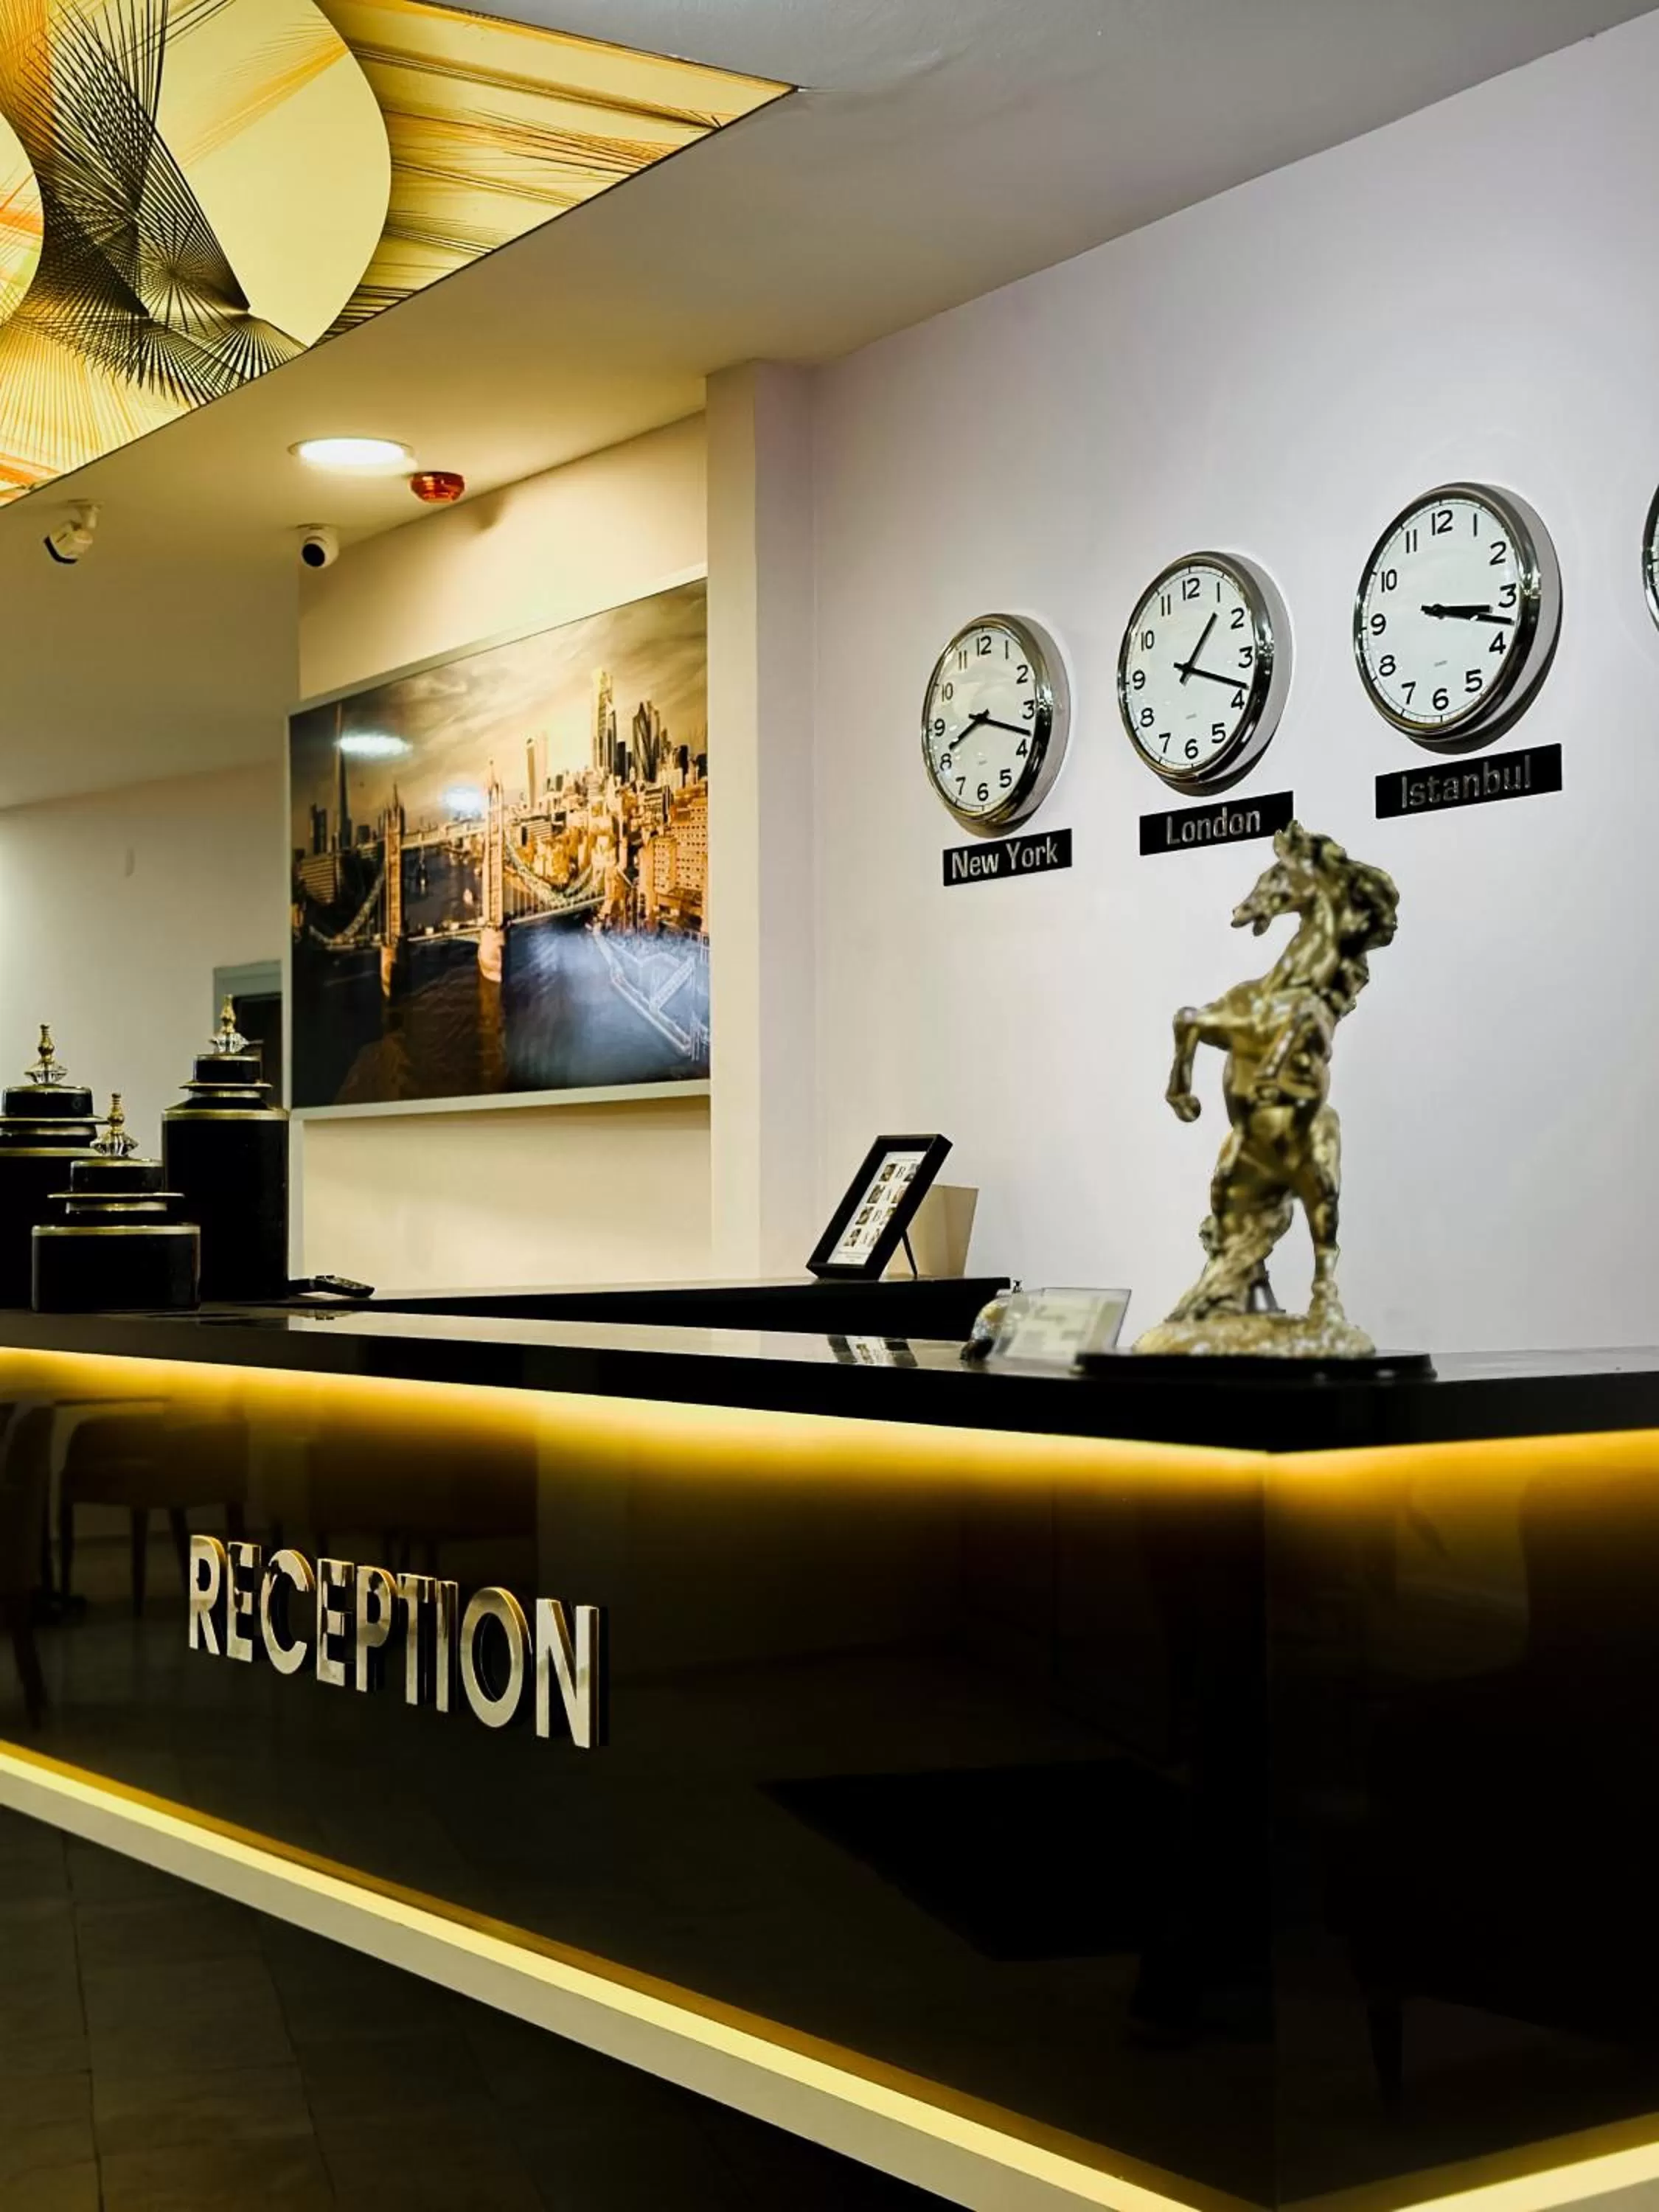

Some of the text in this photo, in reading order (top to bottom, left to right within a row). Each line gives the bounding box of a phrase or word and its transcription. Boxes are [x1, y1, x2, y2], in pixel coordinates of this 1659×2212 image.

[1431, 509, 1453, 536] 12
[1405, 529, 1418, 554] 11
[1489, 540, 1507, 566] 2
[1182, 577, 1200, 601] 12
[1381, 568, 1397, 593] 10
[1161, 594, 1172, 617] 11
[1498, 582, 1517, 608] 3
[1230, 607, 1245, 630] 2
[1370, 613, 1387, 636] 9
[975, 635, 992, 656] 12
[1141, 629, 1155, 652] 10
[1489, 630, 1506, 655] 4
[958, 649, 968, 670] 11
[1238, 645, 1253, 669] 3
[1378, 654, 1397, 678] 8
[1016, 664, 1029, 685] 2
[1132, 669, 1146, 691] 9
[1464, 669, 1483, 693] 5
[941, 682, 954, 703] 10
[1231, 689, 1245, 711] 4
[1401, 681, 1416, 705] 7
[1432, 687, 1450, 712] 6
[1022, 699, 1035, 720] 3
[1139, 707, 1155, 728] 8
[933, 717, 946, 737] 9
[1211, 722, 1228, 745] 5
[1015, 738, 1029, 759] 4
[1158, 732, 1172, 754] 7
[1184, 738, 1199, 760] 6
[939, 752, 953, 772] 8
[955, 776, 967, 796] 7
[999, 768, 1012, 788] 5
[1401, 754, 1532, 810] Istanbul
[977, 782, 989, 802] 6
[1166, 807, 1261, 845] London
[951, 839, 1058, 880] New York
[189, 1534, 601, 1749] RECEPTION
